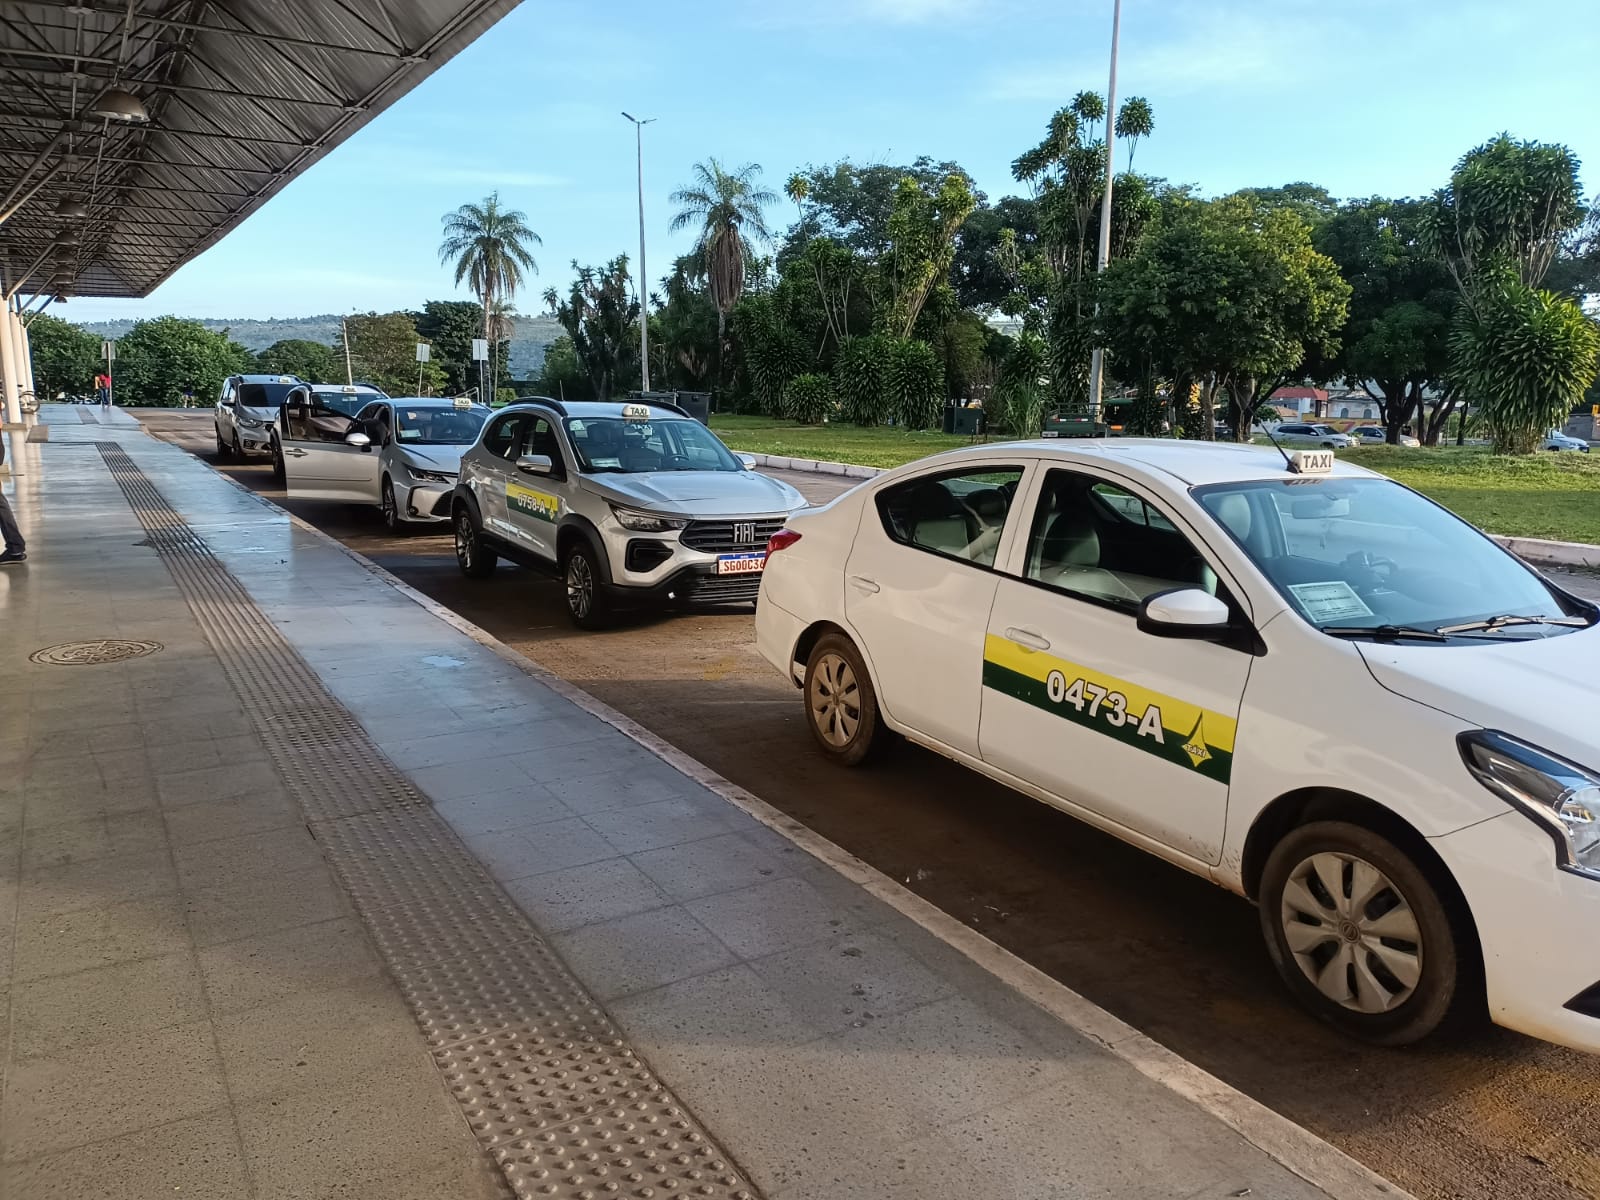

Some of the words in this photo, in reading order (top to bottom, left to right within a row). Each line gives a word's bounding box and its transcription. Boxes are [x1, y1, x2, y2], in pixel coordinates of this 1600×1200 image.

[630, 407, 648, 416] TAXI
[1303, 454, 1332, 469] TAXI
[517, 492, 546, 515] 0758-A
[733, 522, 756, 543] FIAT
[1046, 669, 1165, 744] 0473-A
